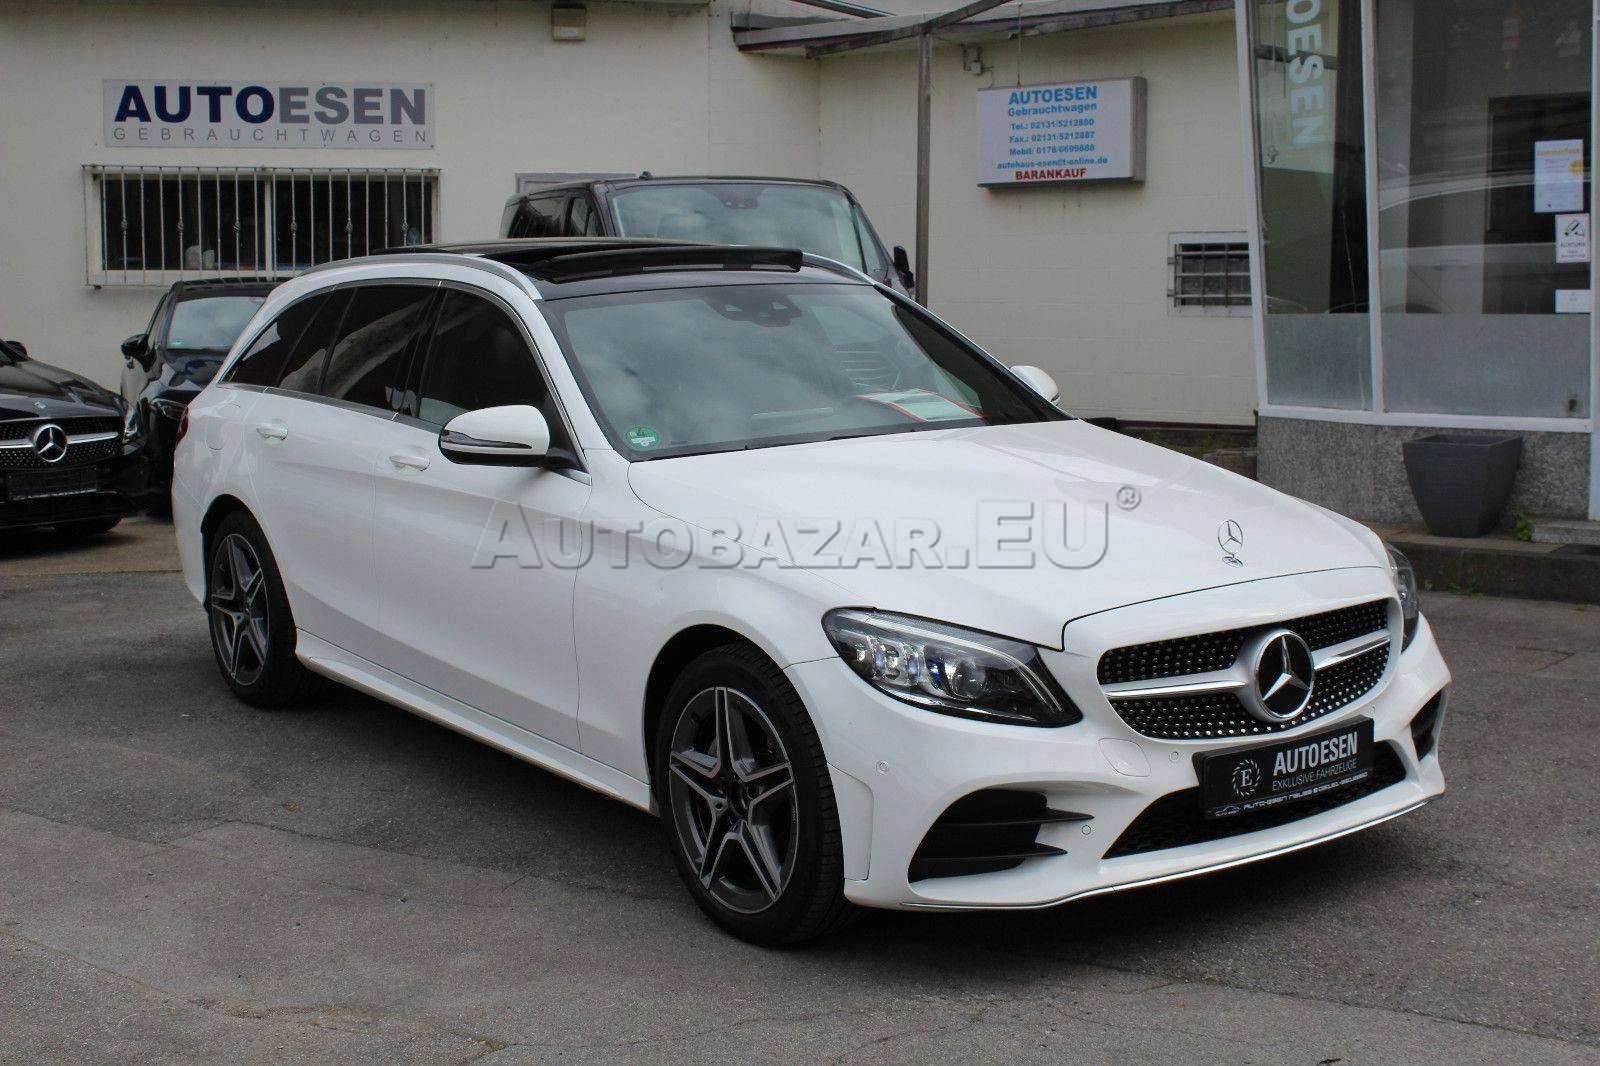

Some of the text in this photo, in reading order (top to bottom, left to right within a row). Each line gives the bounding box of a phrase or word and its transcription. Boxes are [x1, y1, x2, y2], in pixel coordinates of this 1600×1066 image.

[1008, 85, 1098, 105] AUTOESEN
[114, 85, 426, 125] AUTOESEN
[1008, 102, 1097, 117] Gebrauchtwagen
[113, 127, 426, 143] GEBRAUCHTWAGEN
[1009, 147, 1034, 156] Mobil:
[1015, 168, 1087, 181] BARANKAUF
[1272, 771, 1316, 792] EXKLUSIVE
[1316, 757, 1358, 779] FAHRZEUGE
